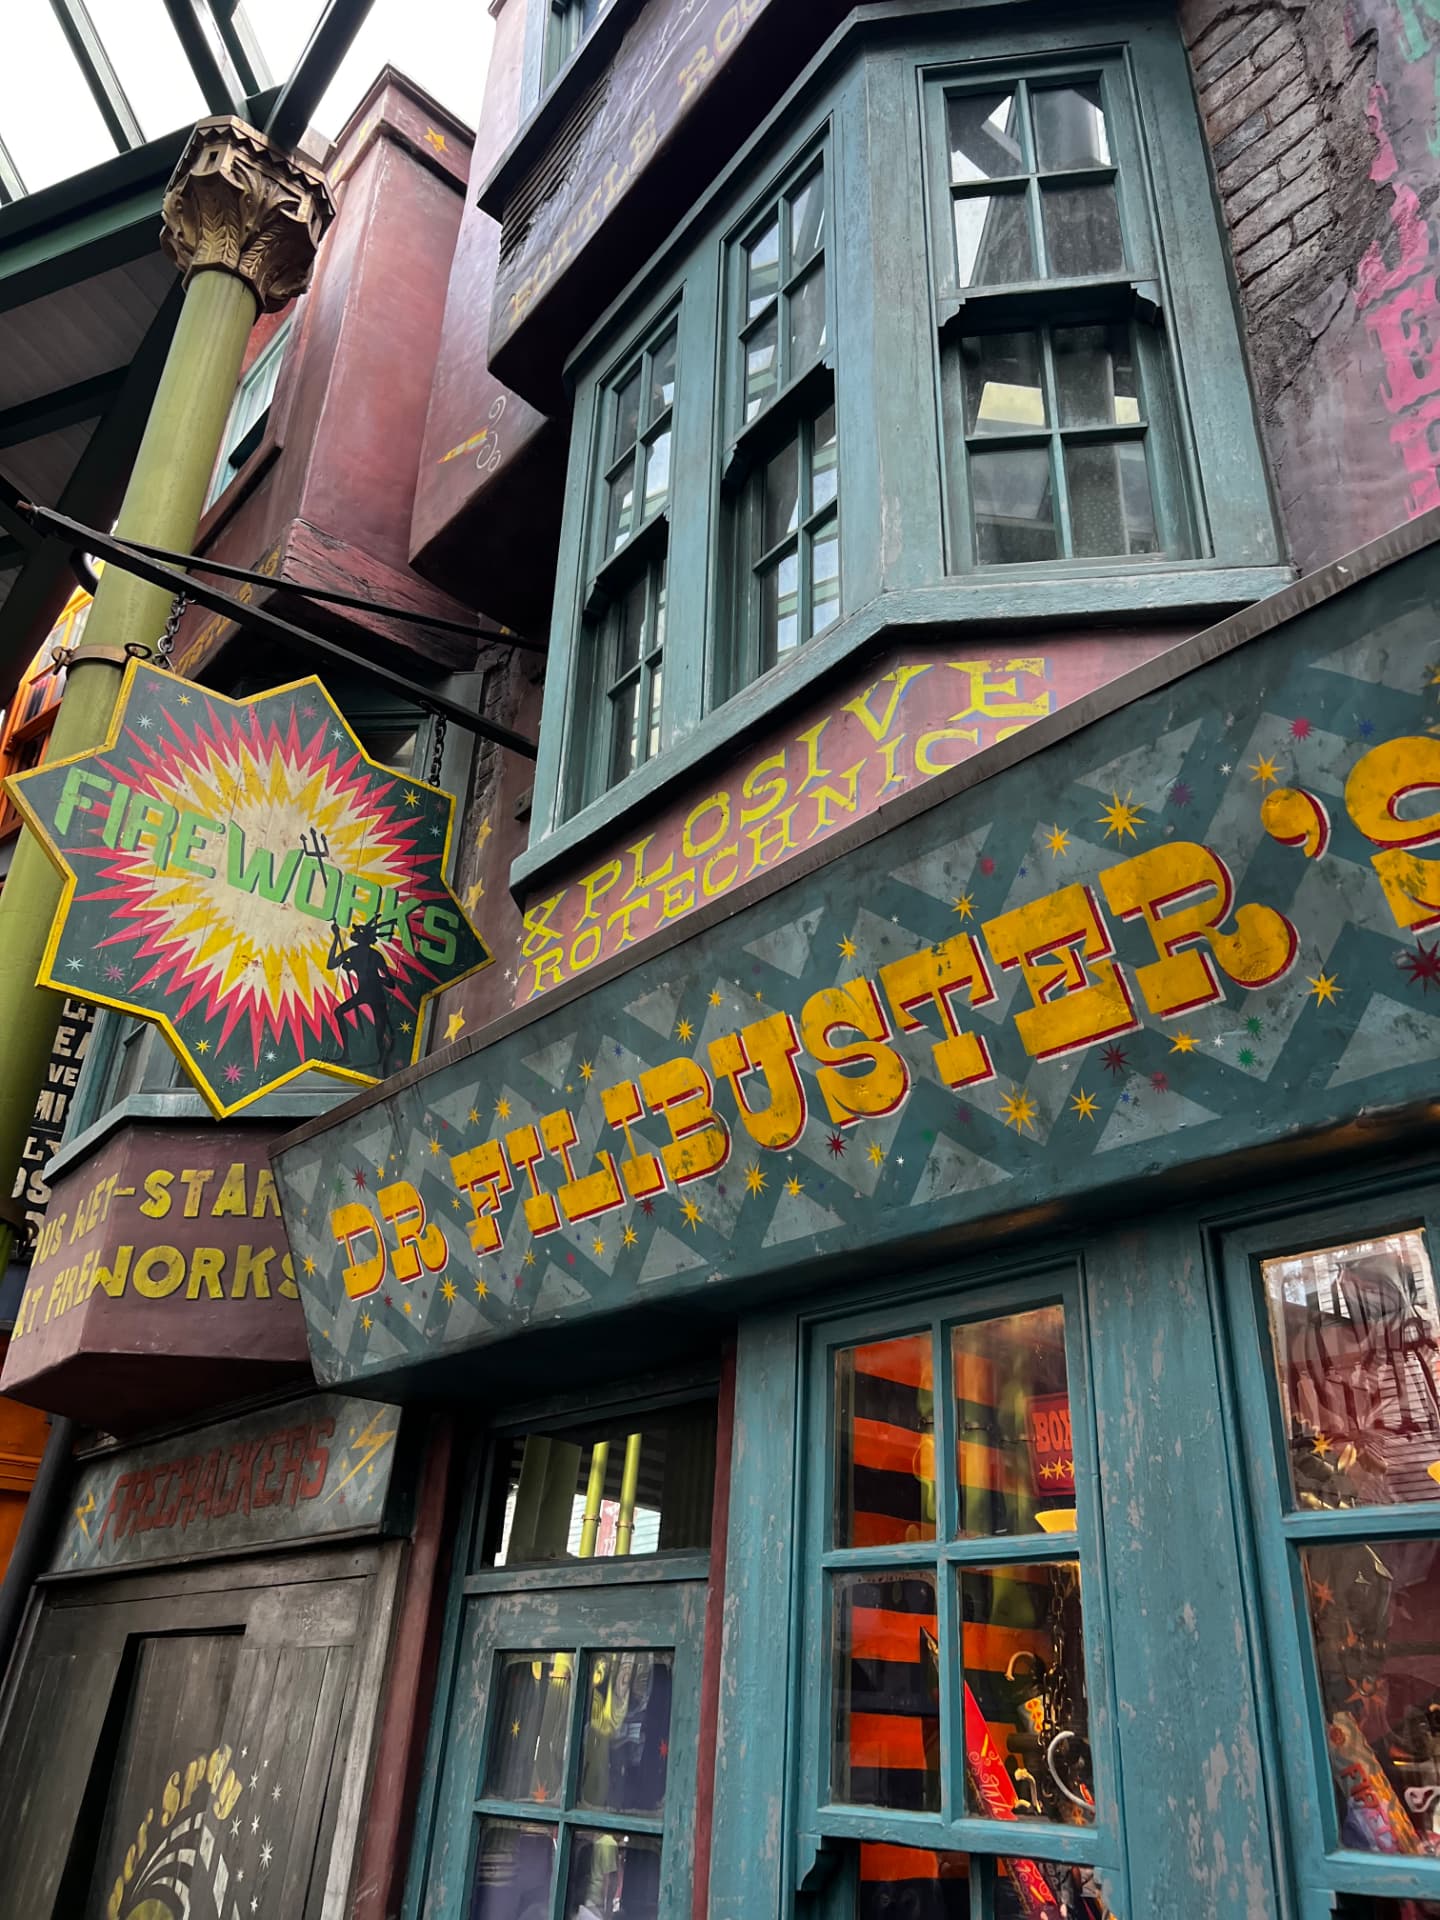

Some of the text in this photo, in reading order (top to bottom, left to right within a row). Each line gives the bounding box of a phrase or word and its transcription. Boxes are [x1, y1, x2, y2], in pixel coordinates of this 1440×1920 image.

[53, 766, 460, 966] FIREWORKS
[330, 735, 1440, 1301] DR FILIBUSTER'S
[98, 1417, 336, 1546] FIRECRACKERS
